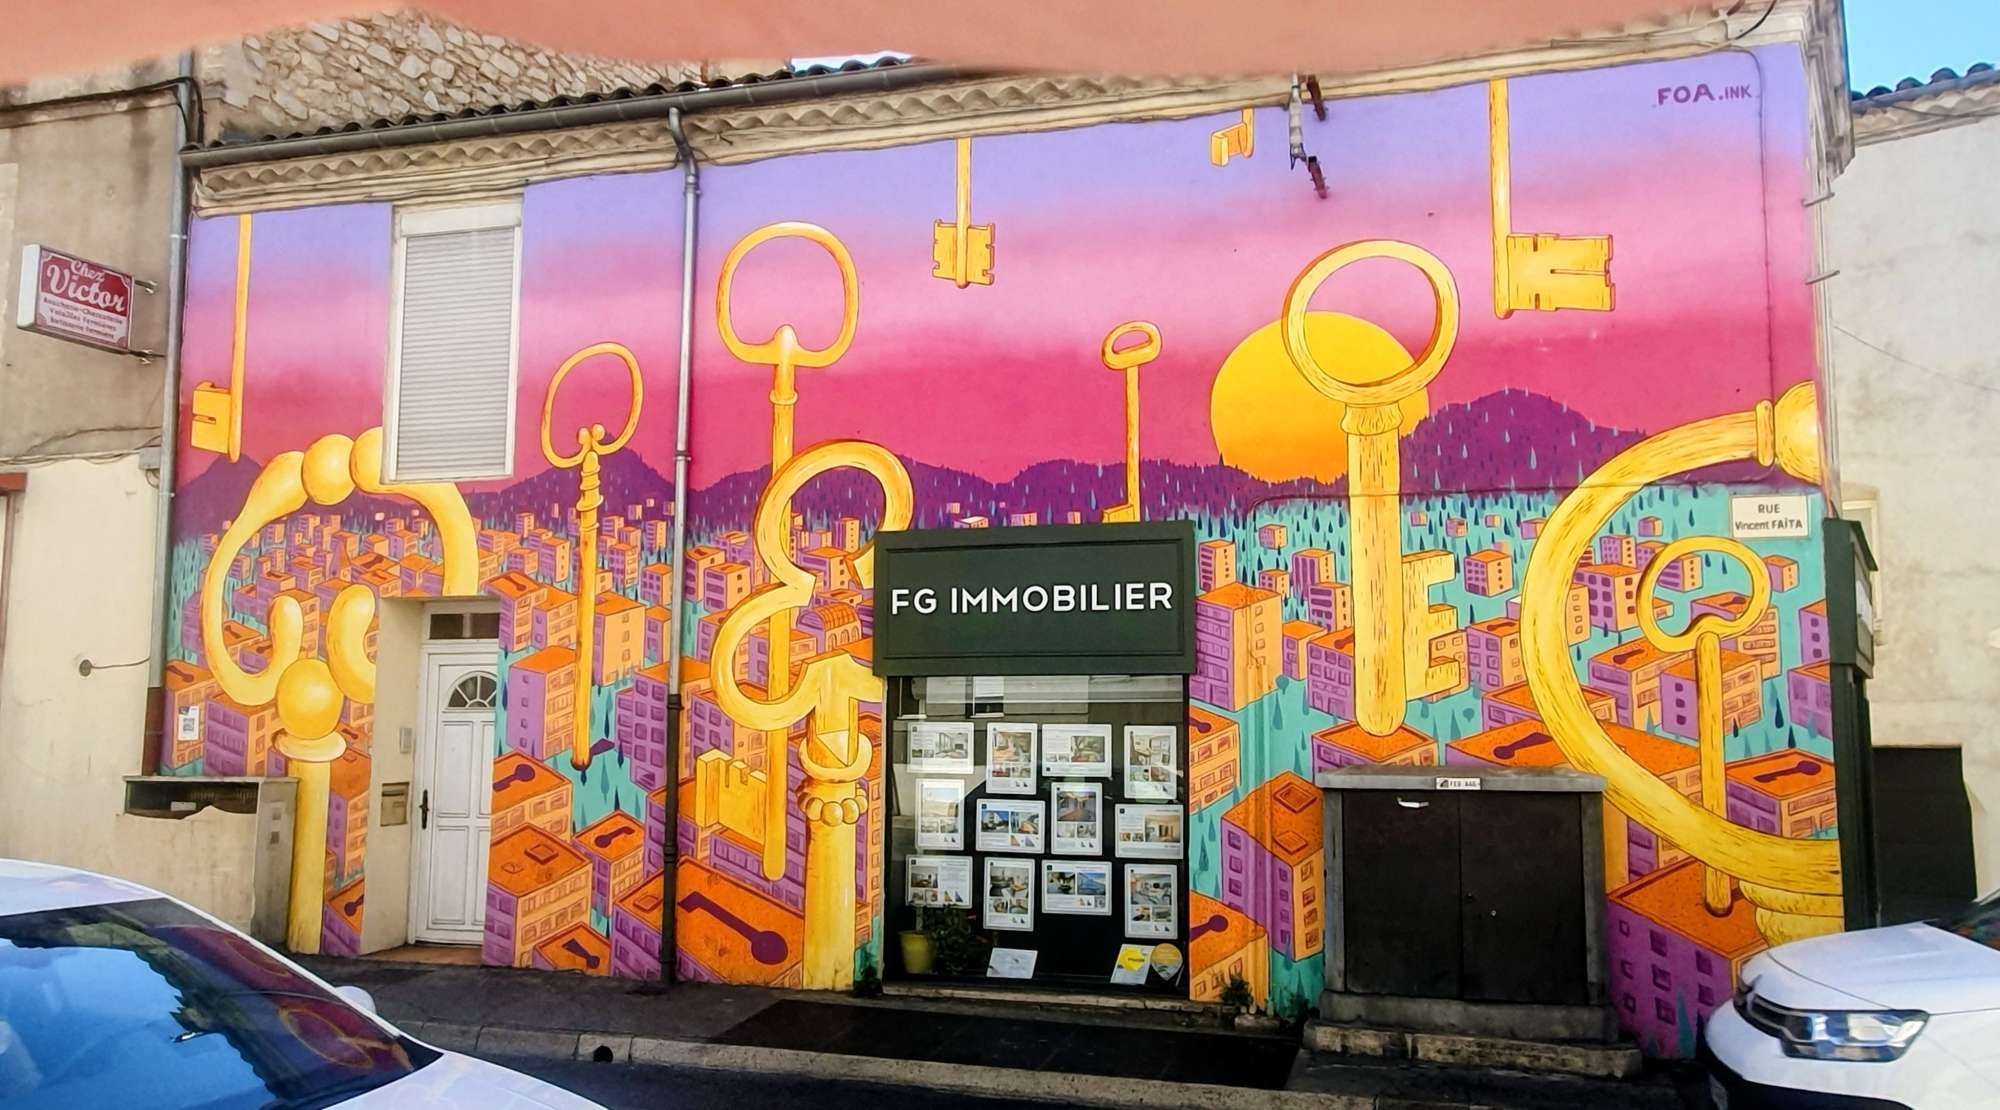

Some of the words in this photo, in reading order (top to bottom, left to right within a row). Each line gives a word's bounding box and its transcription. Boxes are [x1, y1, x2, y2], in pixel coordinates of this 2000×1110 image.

[70, 260, 105, 282] Chez
[46, 264, 125, 312] Victor
[1757, 503, 1781, 514] RUE
[1735, 521, 1769, 530] Vincent
[891, 588, 937, 615] FG
[951, 582, 1173, 613] IMMOBILIER
